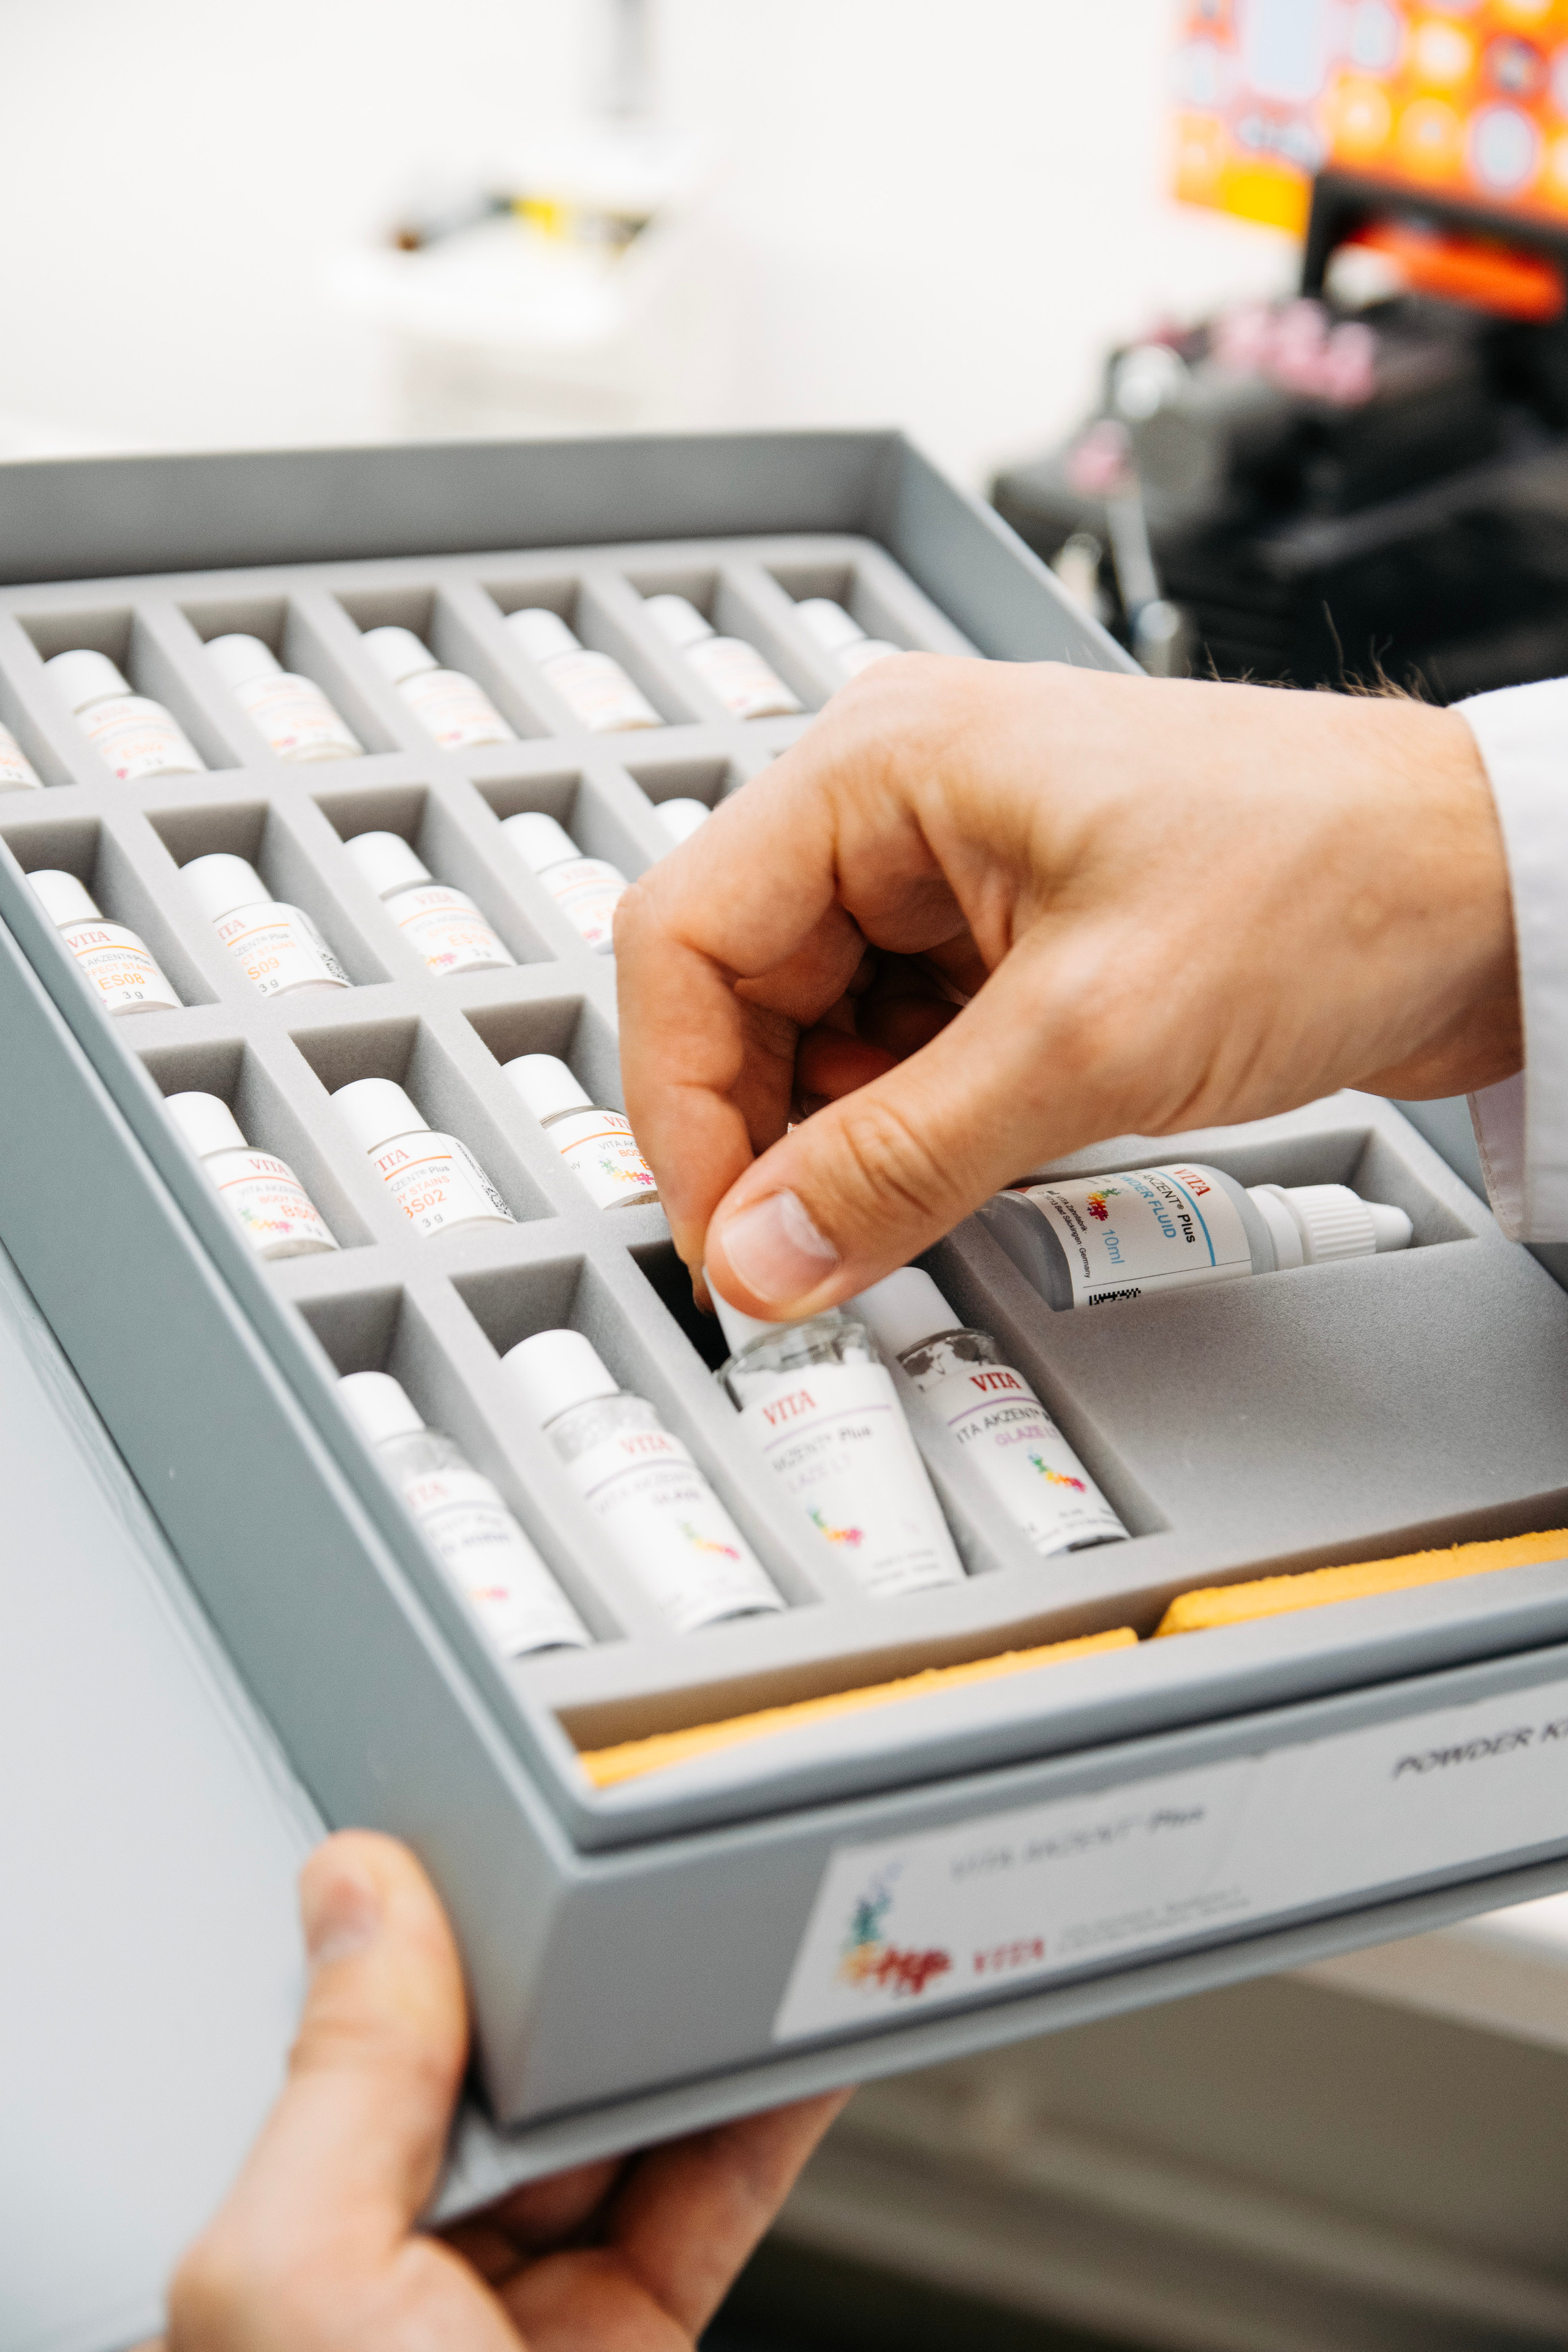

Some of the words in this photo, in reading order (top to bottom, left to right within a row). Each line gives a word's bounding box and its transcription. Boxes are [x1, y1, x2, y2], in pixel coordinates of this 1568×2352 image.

[66, 931, 111, 948] VITA
[217, 919, 246, 940] ITA
[257, 941, 296, 956] STAINS
[86, 963, 119, 978] FFECT
[247, 957, 279, 980] S09
[98, 973, 145, 990] ES08
[259, 984, 267, 992] 3
[270, 979, 278, 988] g
[135, 991, 144, 1000] g
[601, 1116, 632, 1130] VIT
[598, 1140, 623, 1150] VITA
[249, 1159, 290, 1177] VITA
[374, 1148, 410, 1172] ITA
[428, 1166, 450, 1174] Plus
[409, 1175, 450, 1195] STAINS
[1174, 1169, 1212, 1197] VITA
[1141, 1173, 1185, 1210] AKZENT®
[1177, 1213, 1196, 1243] Plus
[422, 1218, 431, 1227] 3
[434, 1213, 443, 1223] g
[1148, 1200, 1177, 1238] FLUID
[1054, 1205, 1066, 1215] Bad
[1079, 1248, 1091, 1278] Germany
[1102, 1229, 1125, 1264] 10ml
[970, 1371, 1022, 1392] VITA
[763, 1389, 817, 1426] VITA
[956, 1422, 982, 1444] ITA
[619, 1434, 673, 1454] VITA
[1392, 1726, 1534, 1781] POWDER
